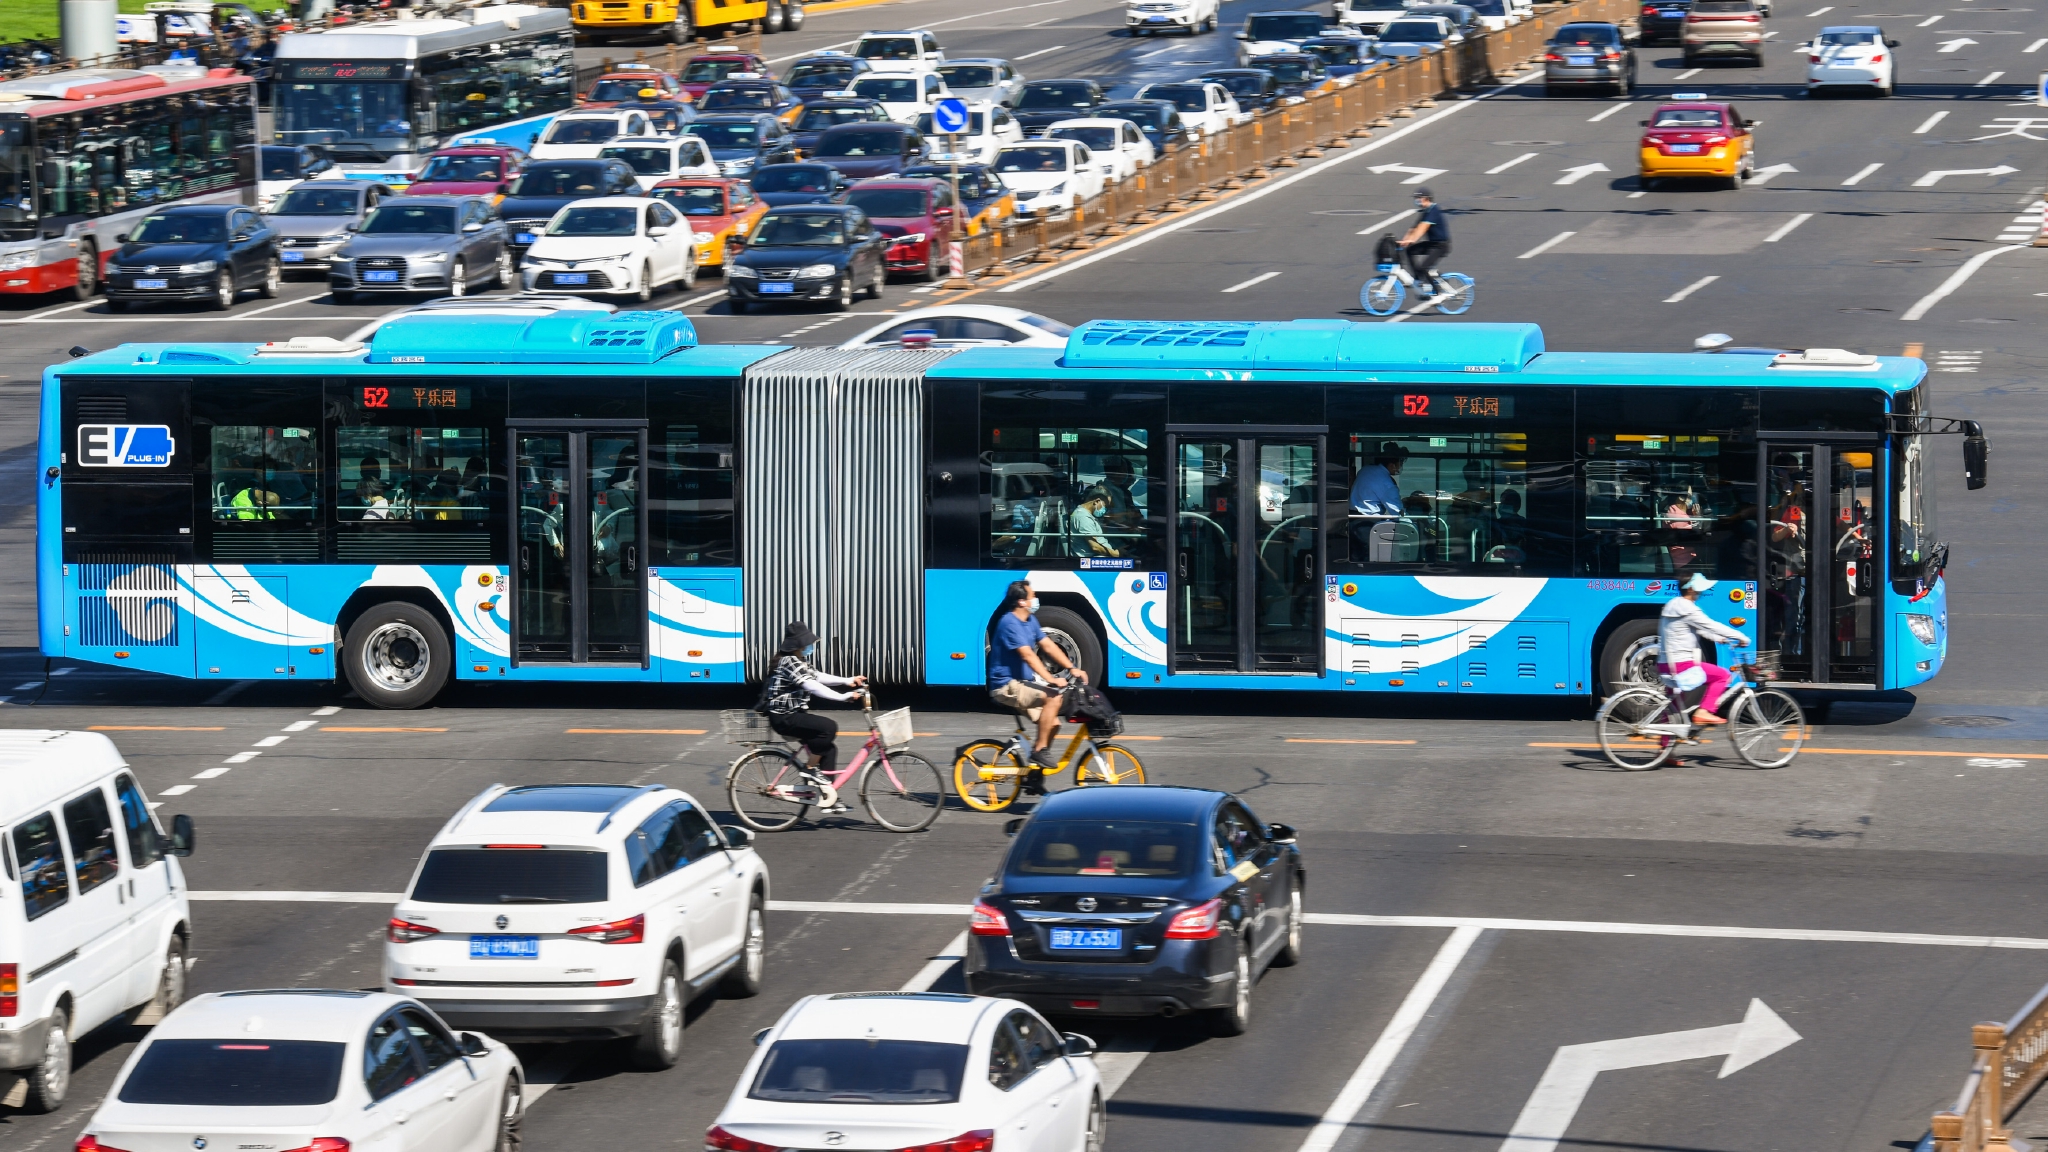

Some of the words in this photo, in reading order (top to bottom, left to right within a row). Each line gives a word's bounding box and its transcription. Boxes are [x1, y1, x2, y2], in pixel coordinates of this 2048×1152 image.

[363, 387, 389, 408] 52
[412, 387, 456, 408] 平乐园
[1403, 394, 1430, 416] 52
[1453, 396, 1499, 416] 平乐园
[1586, 579, 1636, 591] 4838404
